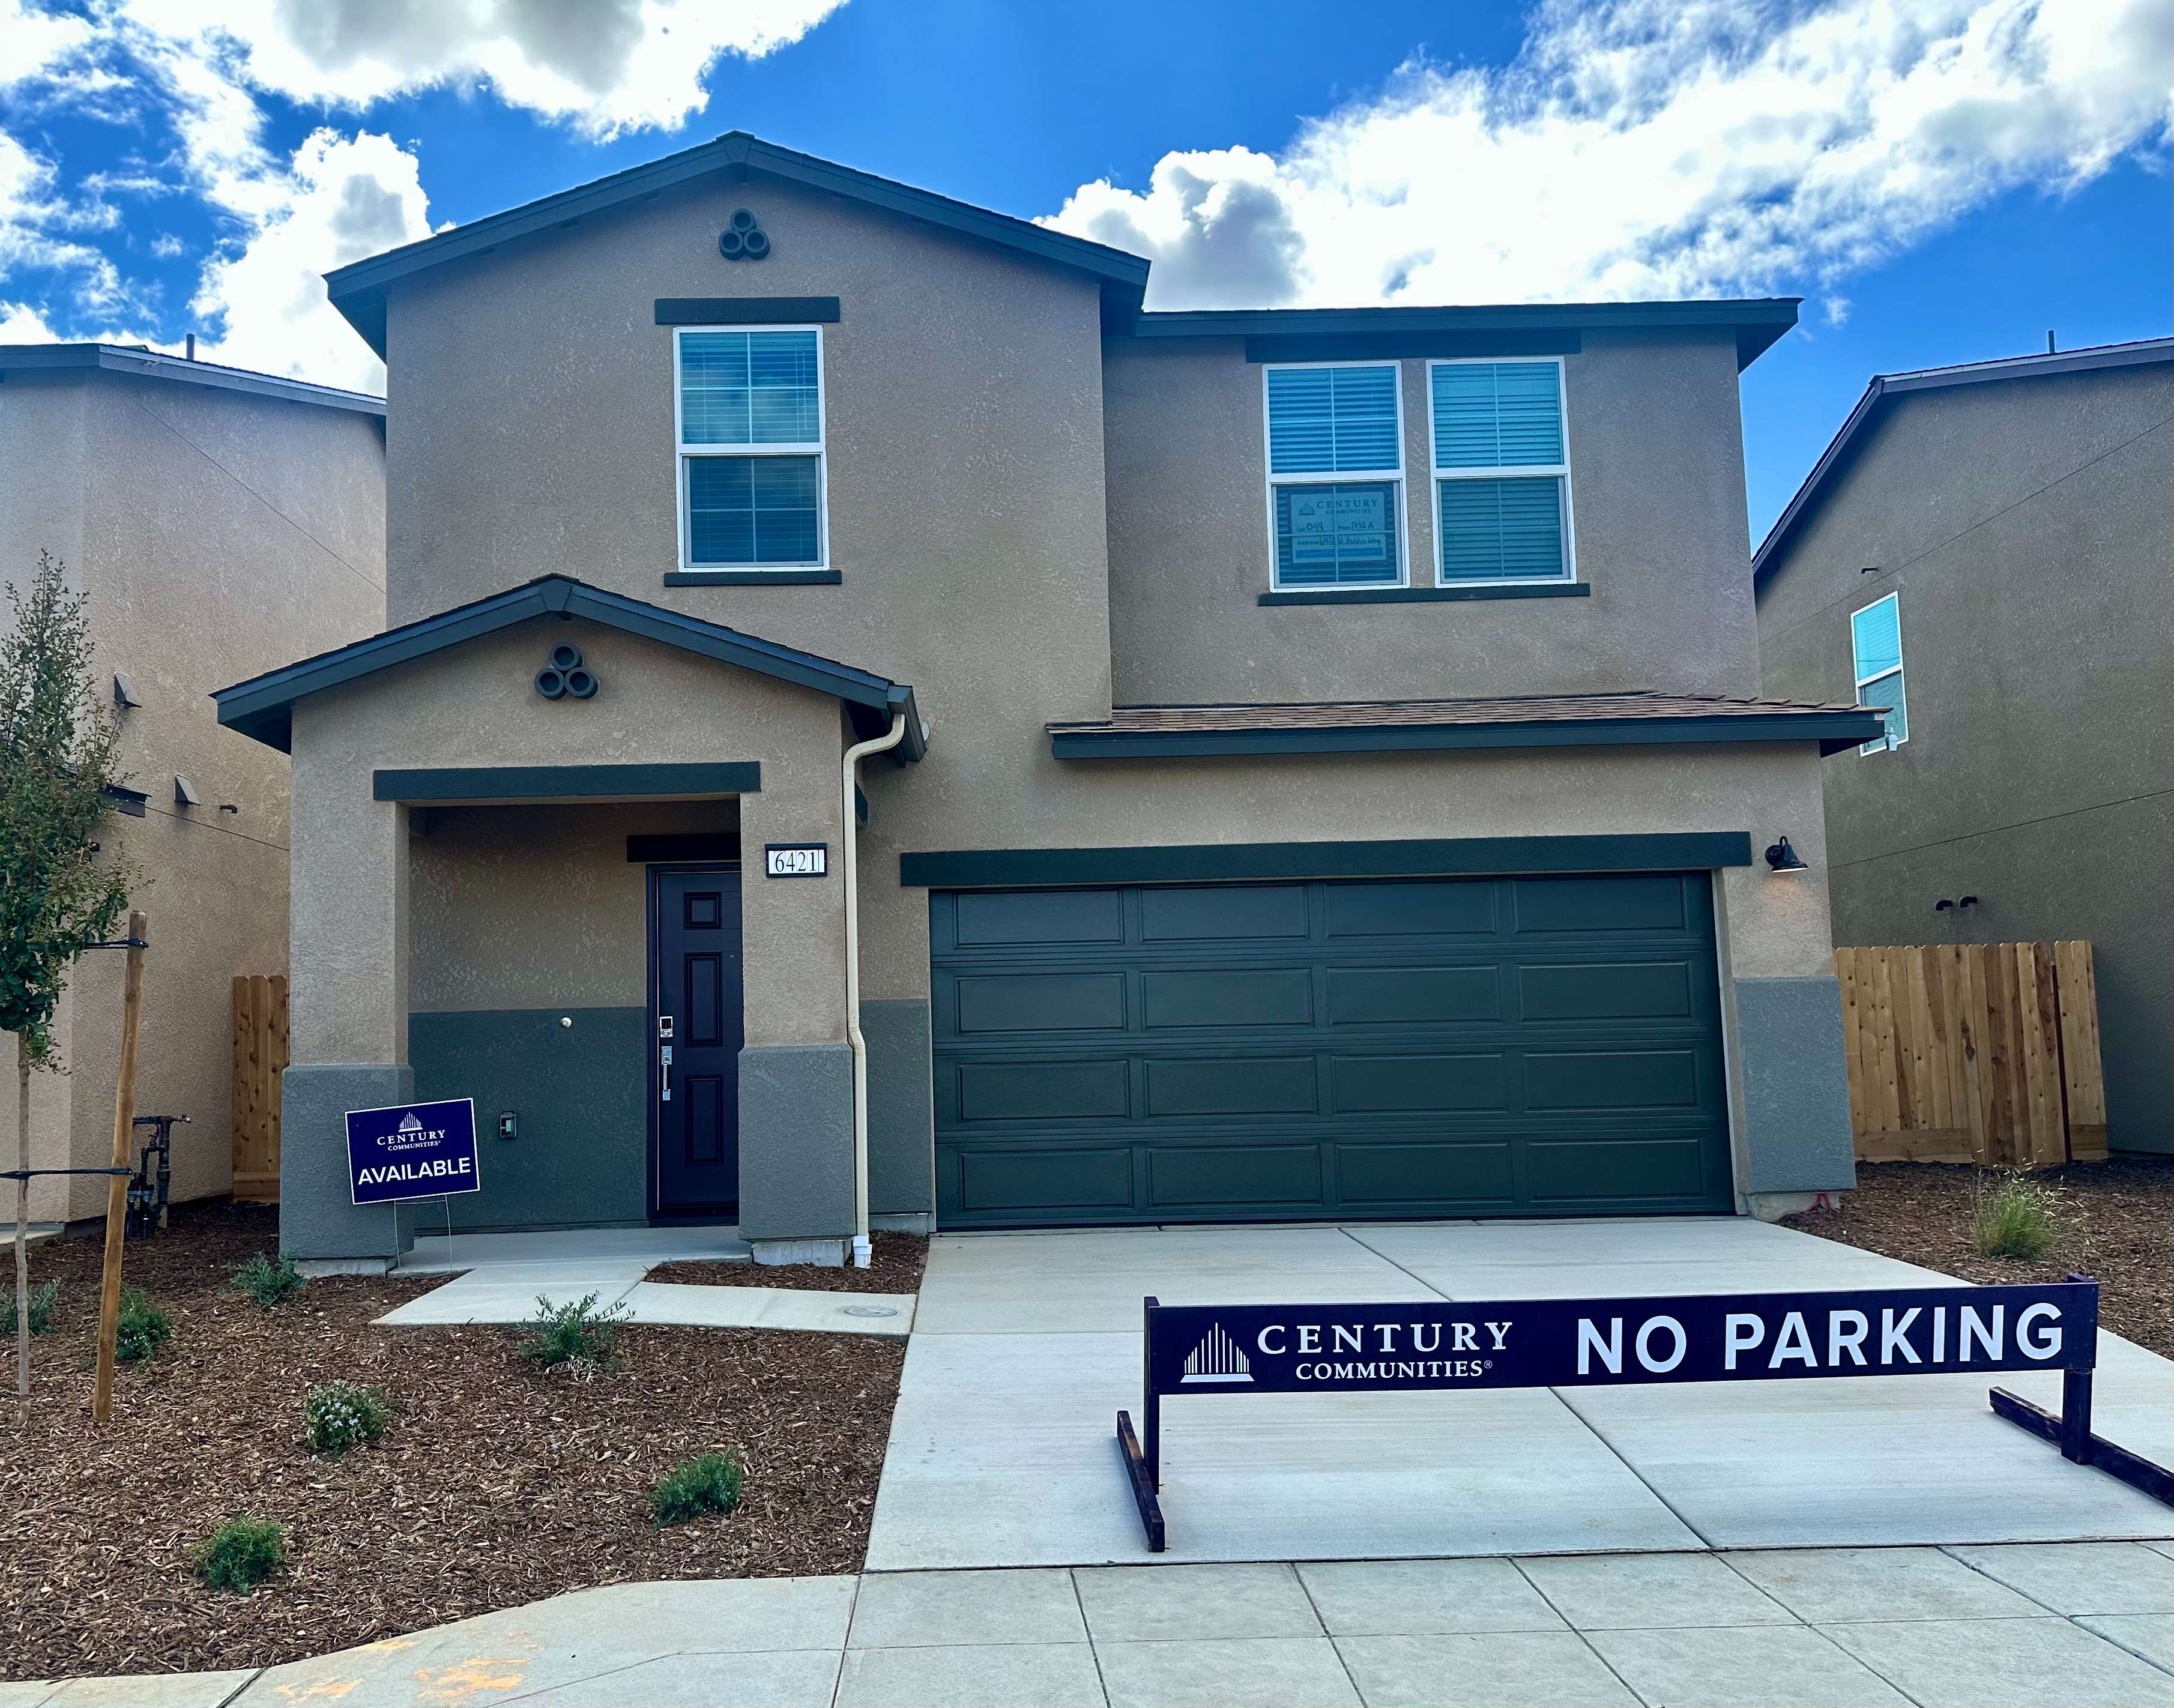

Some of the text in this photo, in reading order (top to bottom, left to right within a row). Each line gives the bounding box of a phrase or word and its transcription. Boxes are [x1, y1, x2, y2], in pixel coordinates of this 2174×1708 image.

[1317, 499, 1378, 509] CENTURY
[775, 851, 817, 872] 6421
[376, 1129, 445, 1145] CENTURY
[358, 1157, 471, 1185] AVAILABLE
[1257, 1321, 1514, 1354] CENTURY
[1577, 1302, 2064, 1375] NO PARKING
